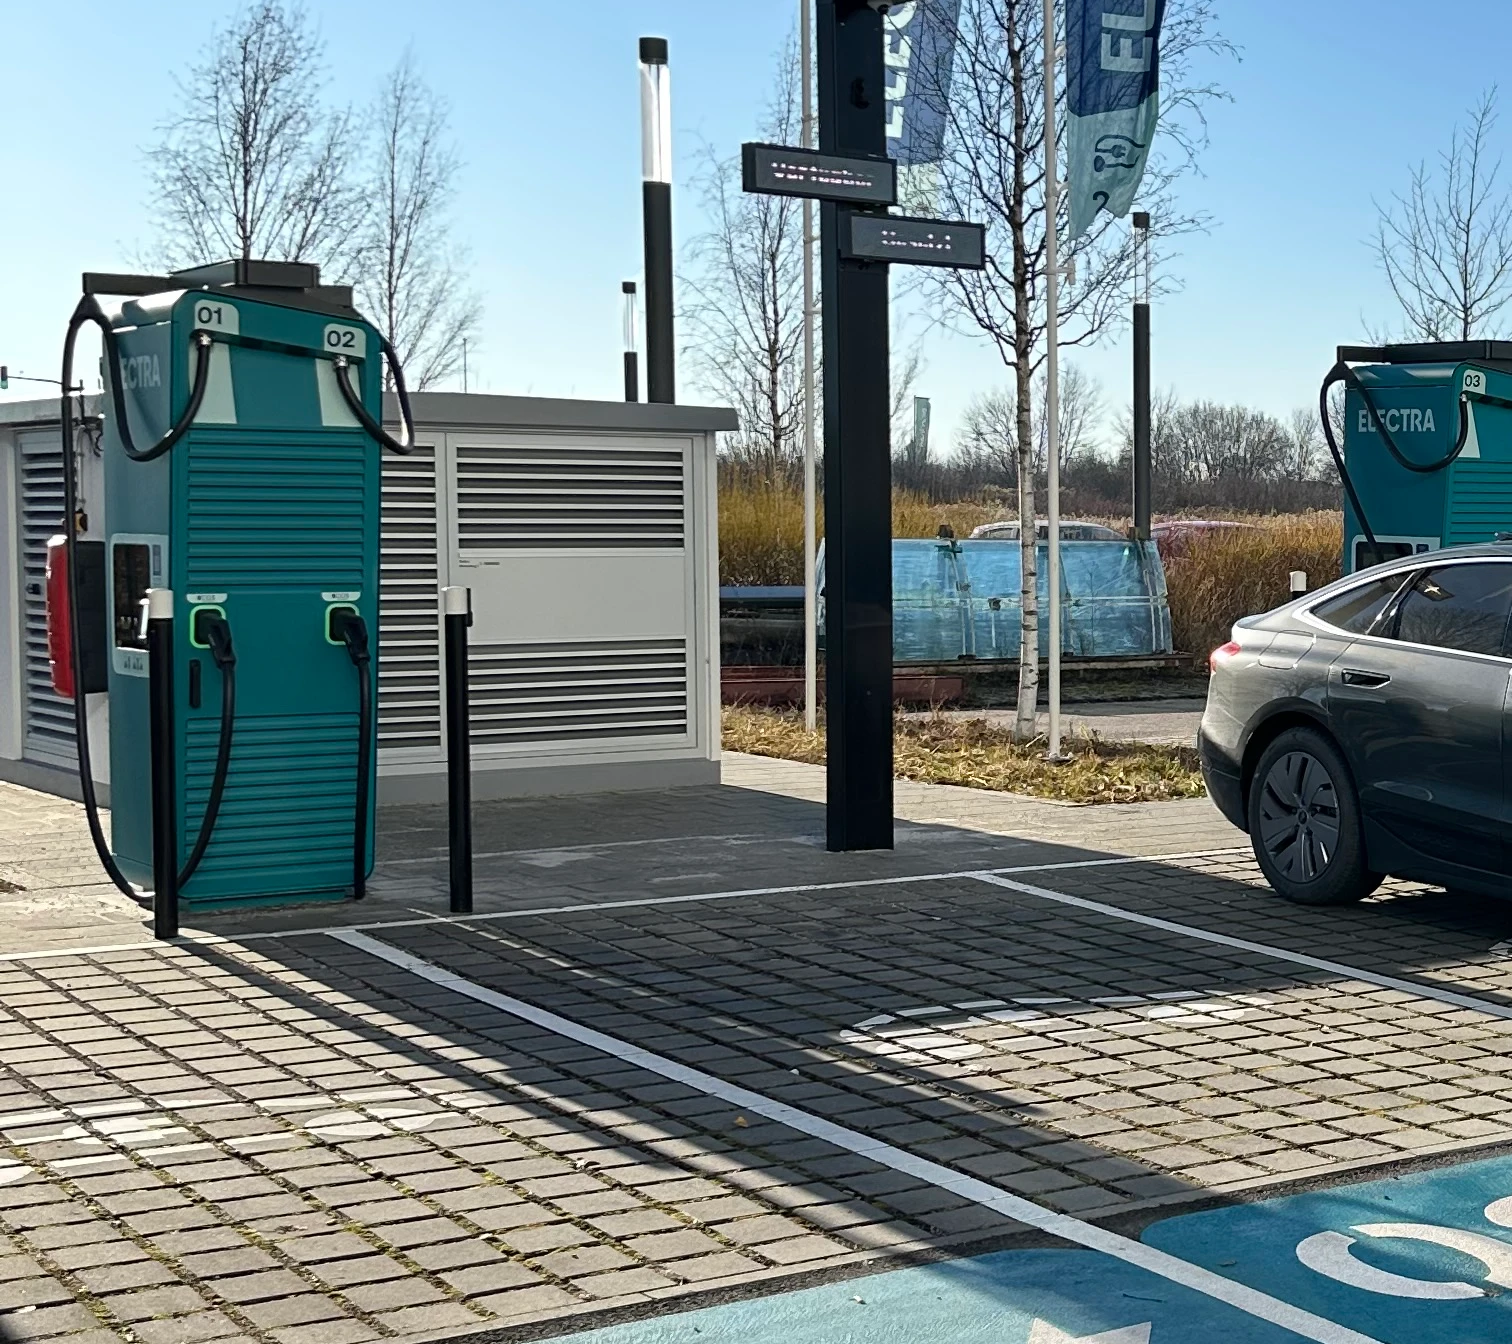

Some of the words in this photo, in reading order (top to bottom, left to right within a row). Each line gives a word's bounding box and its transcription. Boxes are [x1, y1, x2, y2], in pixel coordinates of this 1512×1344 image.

[197, 306, 223, 324] 01
[327, 330, 356, 348] 02
[1464, 374, 1480, 387] 03
